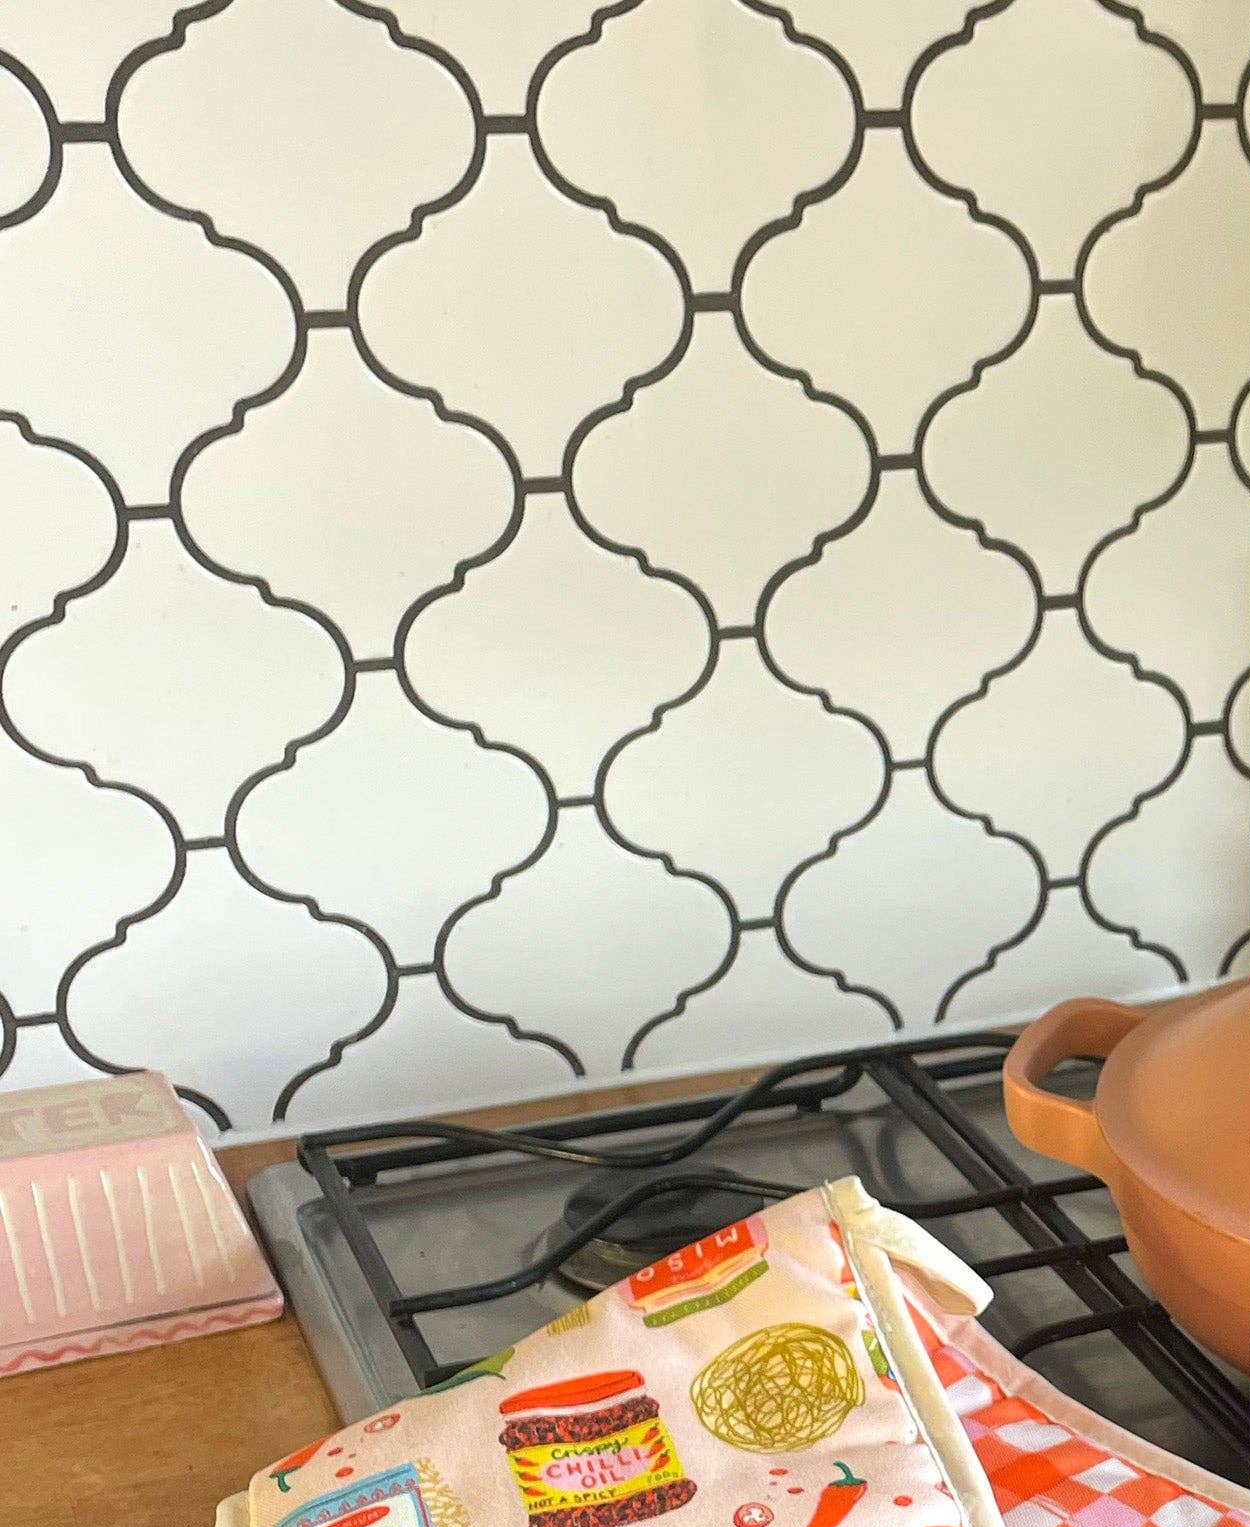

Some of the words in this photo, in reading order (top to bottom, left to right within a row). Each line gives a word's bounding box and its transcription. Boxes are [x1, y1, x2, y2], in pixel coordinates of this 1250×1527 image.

[551, 1437, 629, 1460] Crispy
[546, 1448, 642, 1479] CHILLI
[581, 1471, 625, 1489] OIL
[528, 1497, 552, 1510] HOT
[573, 1488, 616, 1504] SPICY
